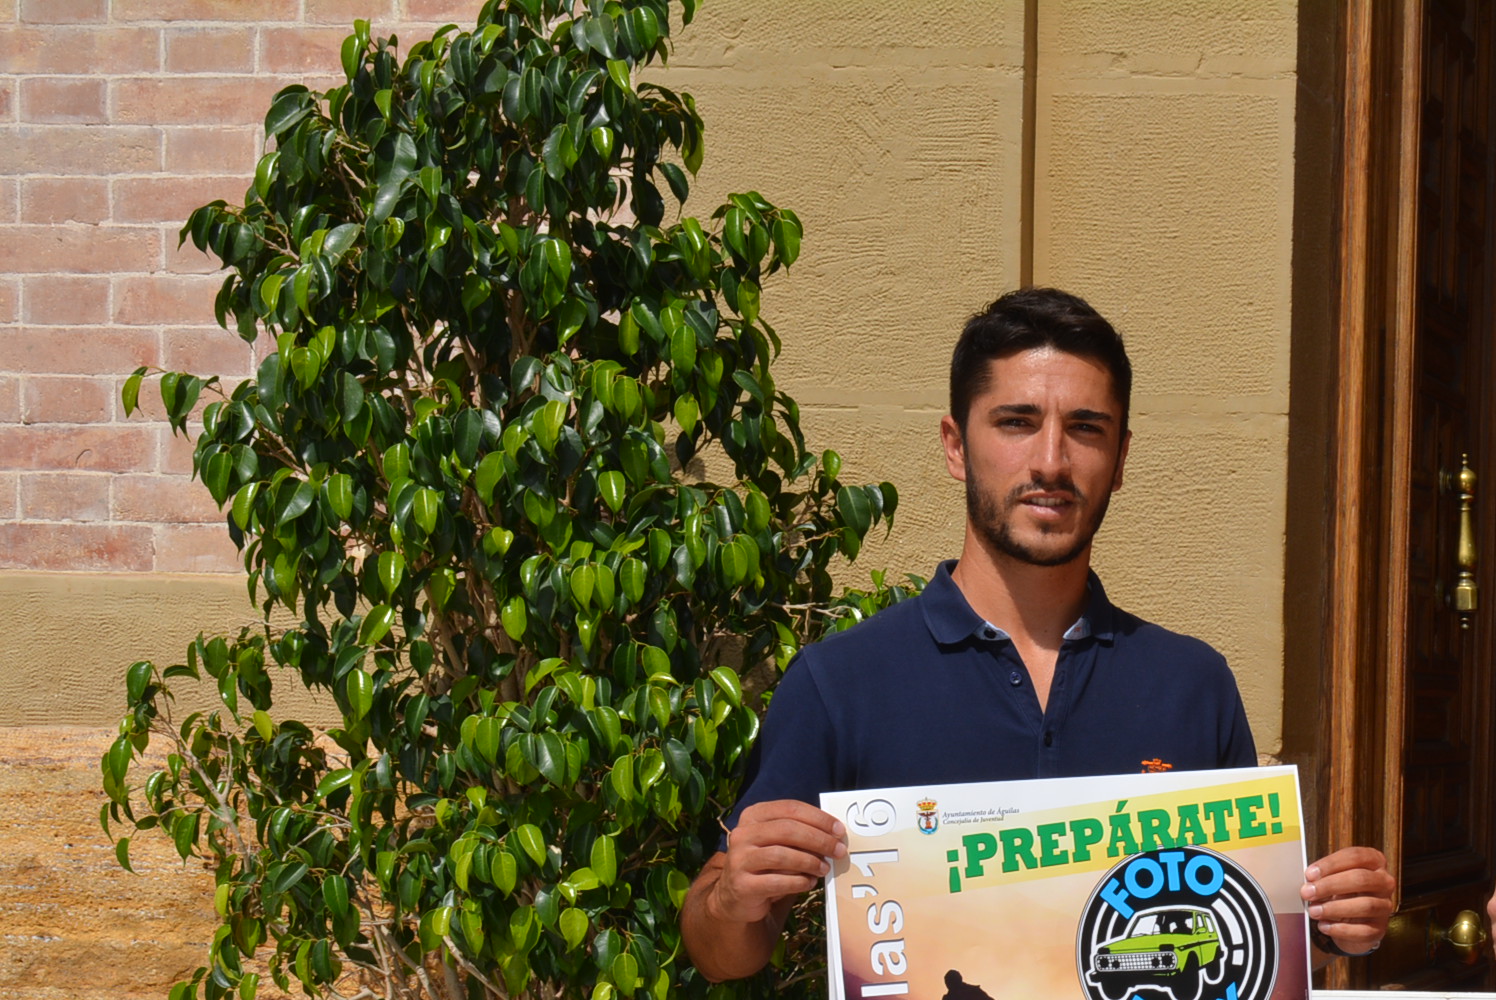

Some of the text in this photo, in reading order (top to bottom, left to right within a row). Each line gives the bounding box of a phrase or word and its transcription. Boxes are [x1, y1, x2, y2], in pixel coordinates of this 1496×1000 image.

[942, 806, 1020, 820] Ayuntamiento de Águilas
[979, 814, 1005, 823] Juventud
[947, 792, 1284, 893] ¡PREPÁRATE!
[1100, 851, 1225, 920] FOTO
